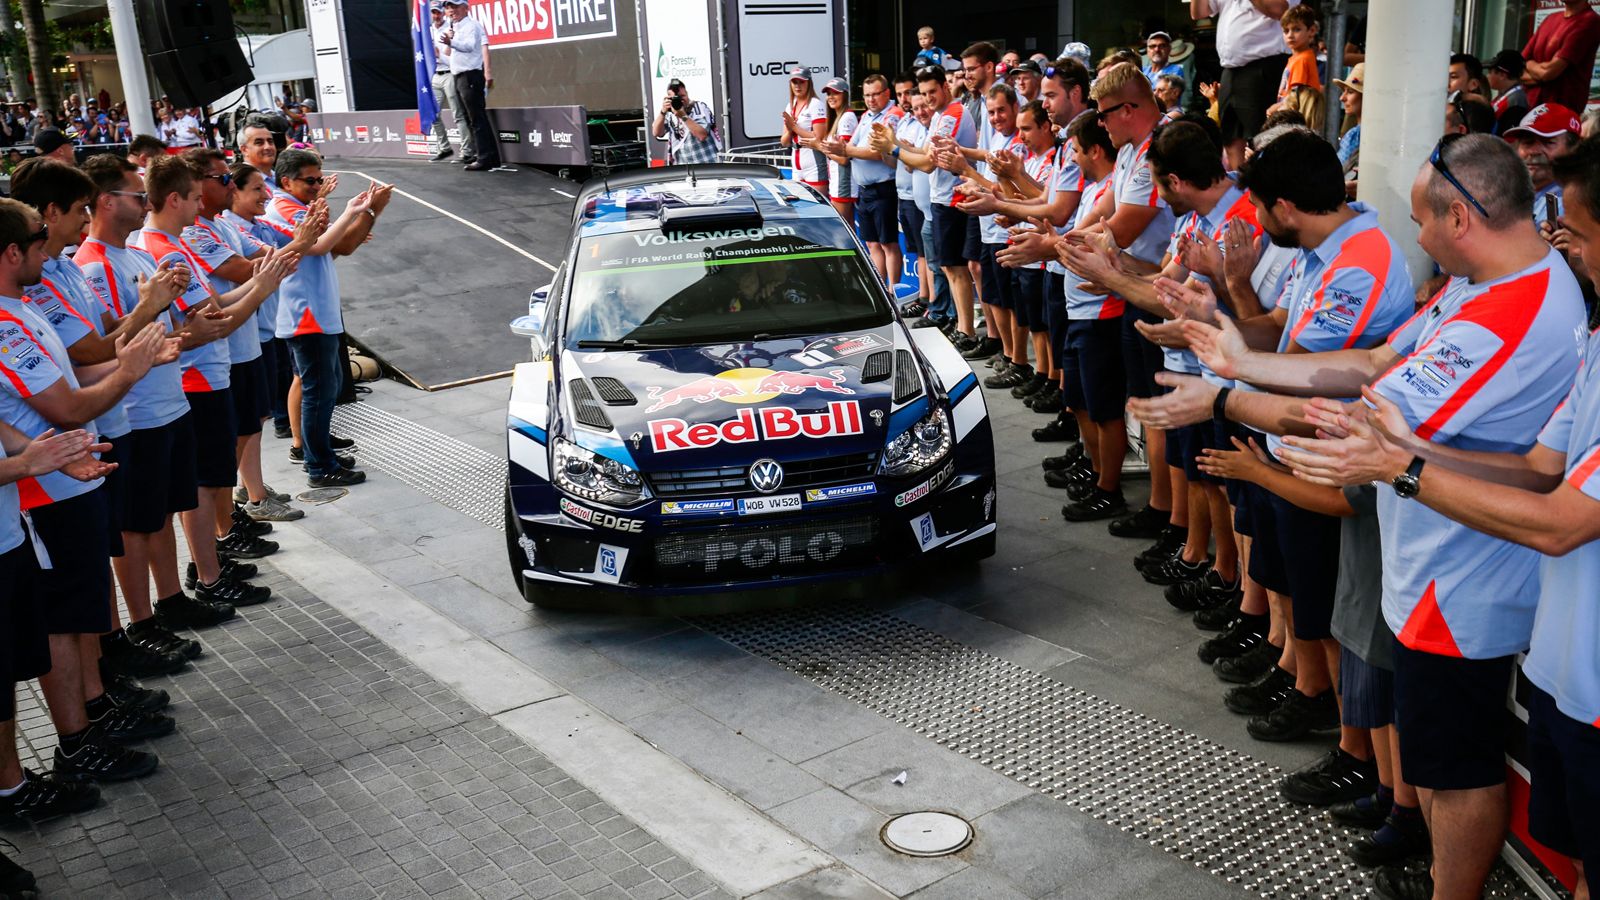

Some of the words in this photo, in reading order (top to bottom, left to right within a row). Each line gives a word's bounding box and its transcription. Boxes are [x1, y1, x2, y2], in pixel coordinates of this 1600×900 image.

[468, 0, 548, 36] NNARDS
[557, 0, 607, 26] HIRE
[671, 56, 697, 66] Forestry
[672, 67, 706, 77] Corporation
[550, 129, 574, 143] Lexar
[633, 225, 796, 247] Volkswagen
[588, 243, 600, 258] 1
[651, 253, 683, 262] World
[685, 250, 712, 260] Rally
[715, 244, 789, 257] Championship
[1333, 291, 1363, 306] MOBIS
[25, 356, 44, 370] WIA
[802, 353, 822, 363] 1
[649, 408, 757, 452] Red
[760, 401, 862, 439] Bull
[904, 483, 929, 503] Castrol
[929, 458, 955, 492] EDGE
[828, 483, 875, 496] MICHELIN
[683, 501, 732, 510] MICHELIN
[746, 501, 764, 510] WOB
[769, 499, 781, 508] VW
[782, 497, 800, 507] 528
[566, 502, 591, 520] Castrol
[591, 511, 645, 533] EDGE
[705, 531, 845, 573] POLO
